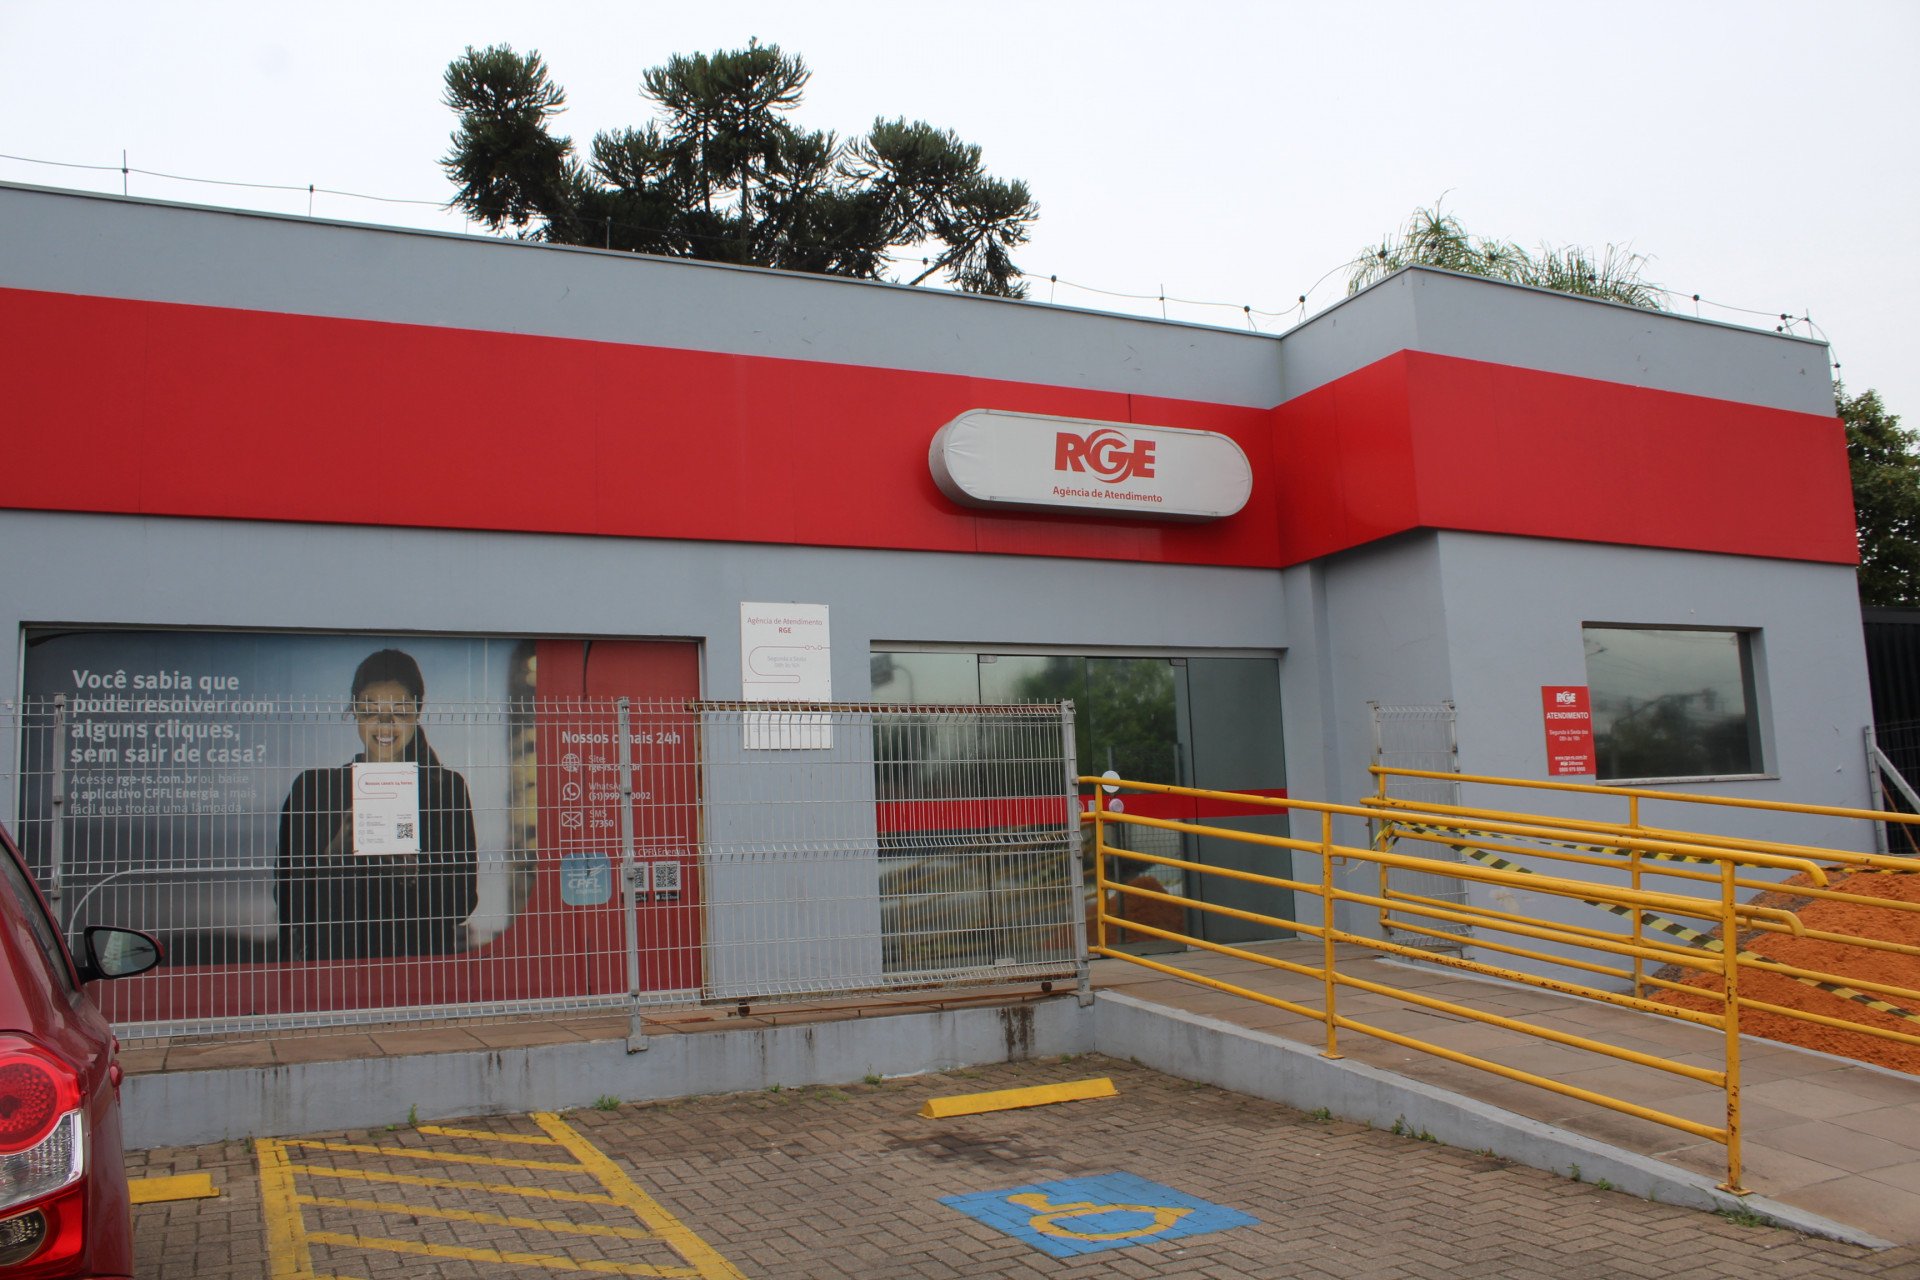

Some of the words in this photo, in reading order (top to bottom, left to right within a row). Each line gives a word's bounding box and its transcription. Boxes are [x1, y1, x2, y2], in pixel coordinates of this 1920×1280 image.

[1055, 428, 1156, 484] RGE
[1053, 486, 1090, 498] Agência
[1091, 488, 1103, 498] de
[1104, 490, 1163, 503] Atendimento
[747, 616, 772, 626] Agência
[774, 617, 782, 625] de
[783, 618, 823, 626] Atendimento
[72, 669, 127, 689] Você
[133, 670, 193, 690] sabia
[199, 674, 240, 695] que
[1555, 691, 1576, 705] RGE
[73, 694, 130, 717] pode
[136, 694, 225, 714] resolver
[231, 699, 274, 714] com
[1546, 711, 1589, 720] ATENDIMENTO
[71, 719, 148, 743] alguns
[154, 719, 241, 743] cliques,
[561, 731, 609, 744] Nossos
[612, 731, 653, 744] cnais
[656, 731, 681, 745] 24h
[70, 747, 117, 763] sem
[125, 743, 168, 763] sair
[174, 743, 200, 763] de
[206, 743, 267, 763] casa?
[71, 774, 114, 785] Acesse
[117, 773, 198, 787] rge-rs.com.br
[200, 776, 214, 785] ou
[218, 773, 249, 785] baixe
[70, 791, 78, 800] o
[81, 789, 141, 802] aplicativo
[144, 788, 173, 799] CPFL
[175, 788, 219, 801] Energia
[70, 802, 96, 815] fácil
[99, 805, 122, 818] que
[125, 804, 160, 815] trocar
[163, 805, 187, 815] uma
[589, 809, 608, 818] SMS
[568, 877, 601, 888] CPFL
